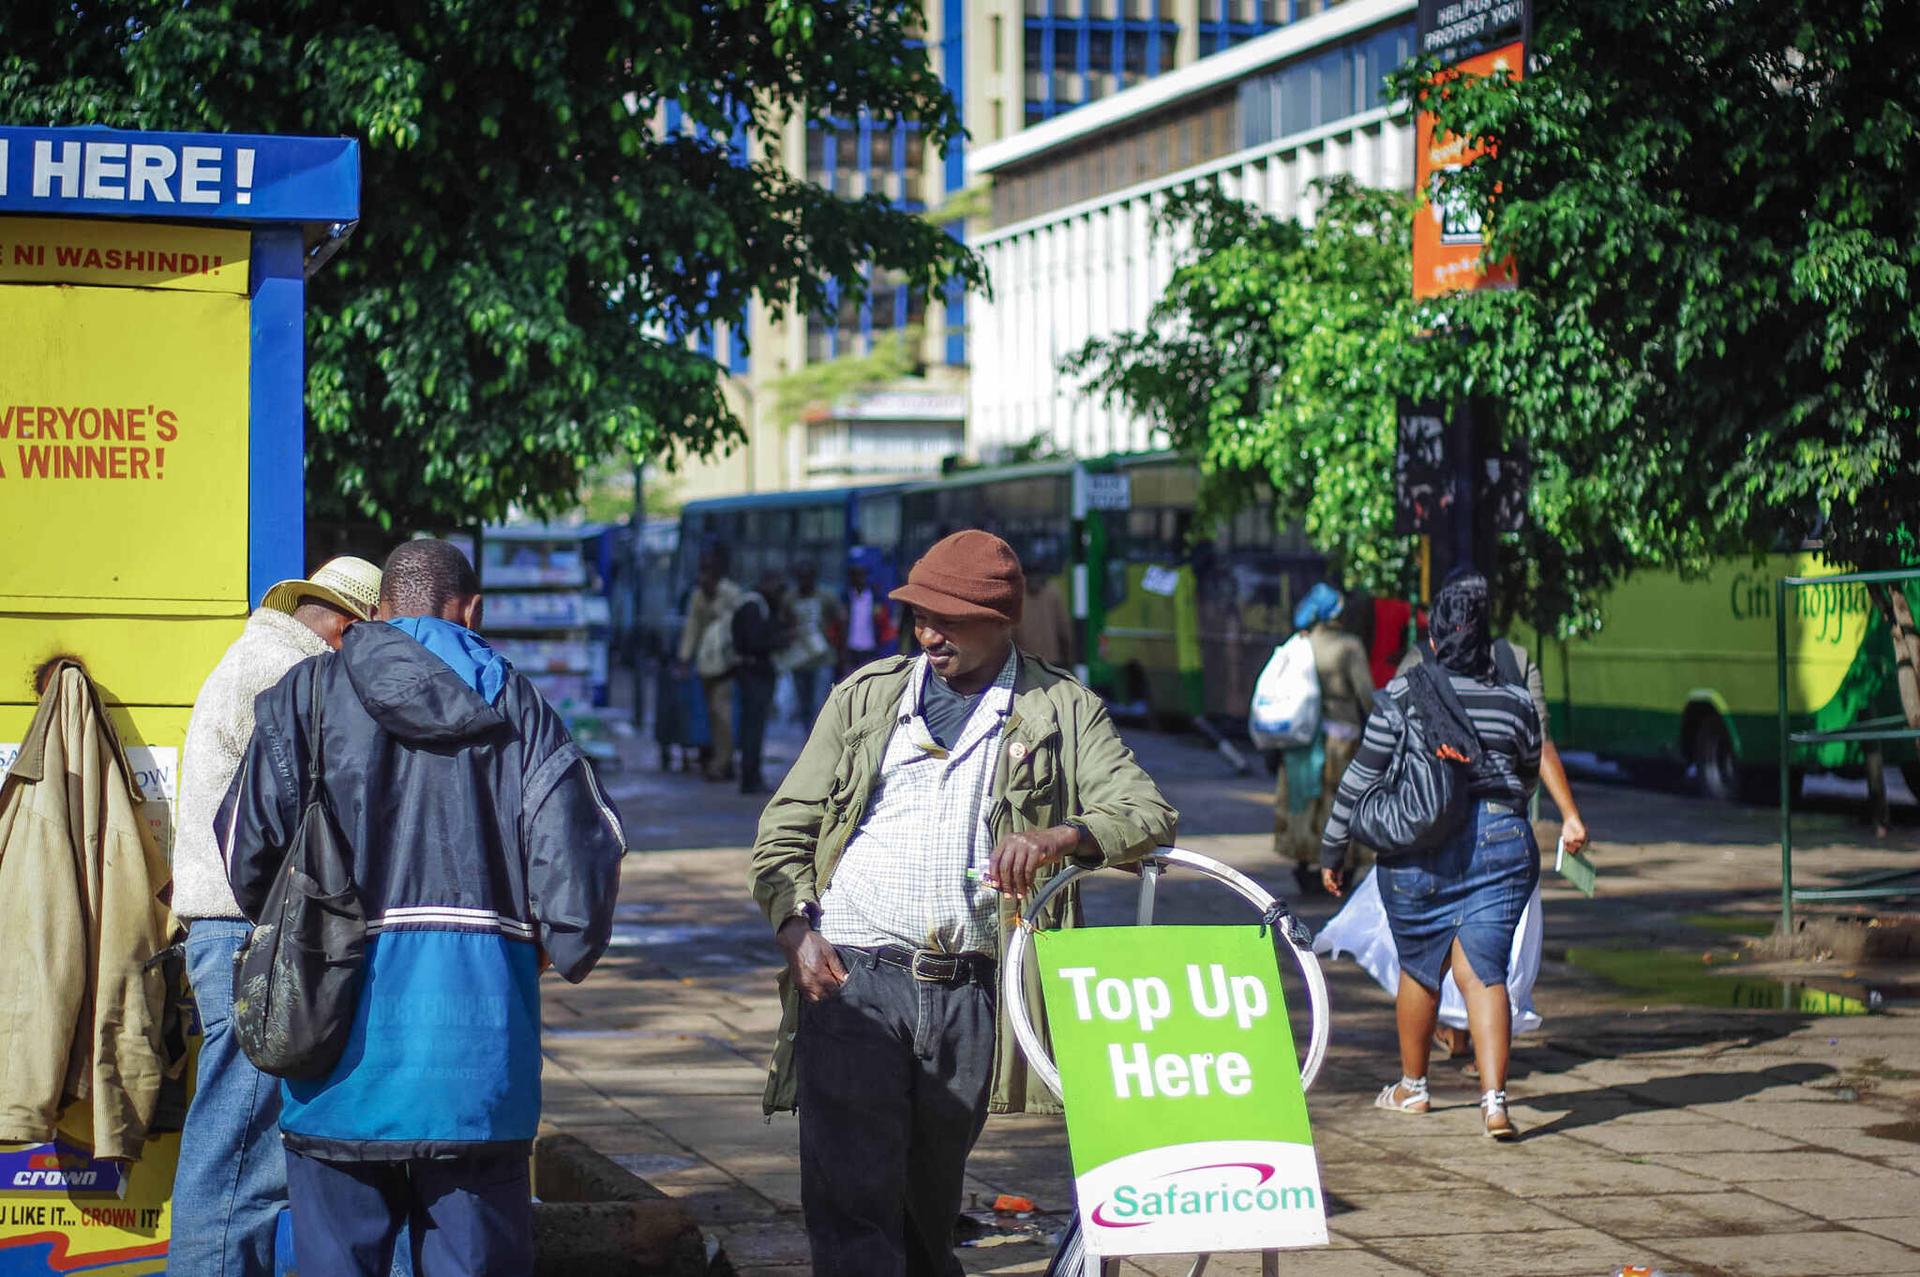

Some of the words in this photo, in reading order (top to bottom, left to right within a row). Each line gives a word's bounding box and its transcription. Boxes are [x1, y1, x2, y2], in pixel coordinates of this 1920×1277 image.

[1424, 12, 1486, 50] PROTECT
[14, 244, 44, 266] NI
[56, 246, 222, 275] WASHINDI!
[18, 445, 164, 479] WINNER!
[1731, 571, 1770, 621] Citi
[1058, 967, 1171, 1031] Top
[1186, 963, 1268, 1030] Up
[1107, 1043, 1253, 1099] Here
[13, 1171, 97, 1186] crown
[11, 1206, 45, 1225] LIKE
[81, 1208, 136, 1228] CROWN
[141, 1208, 160, 1229] IT!
[1113, 1183, 1315, 1218] Safaricom
